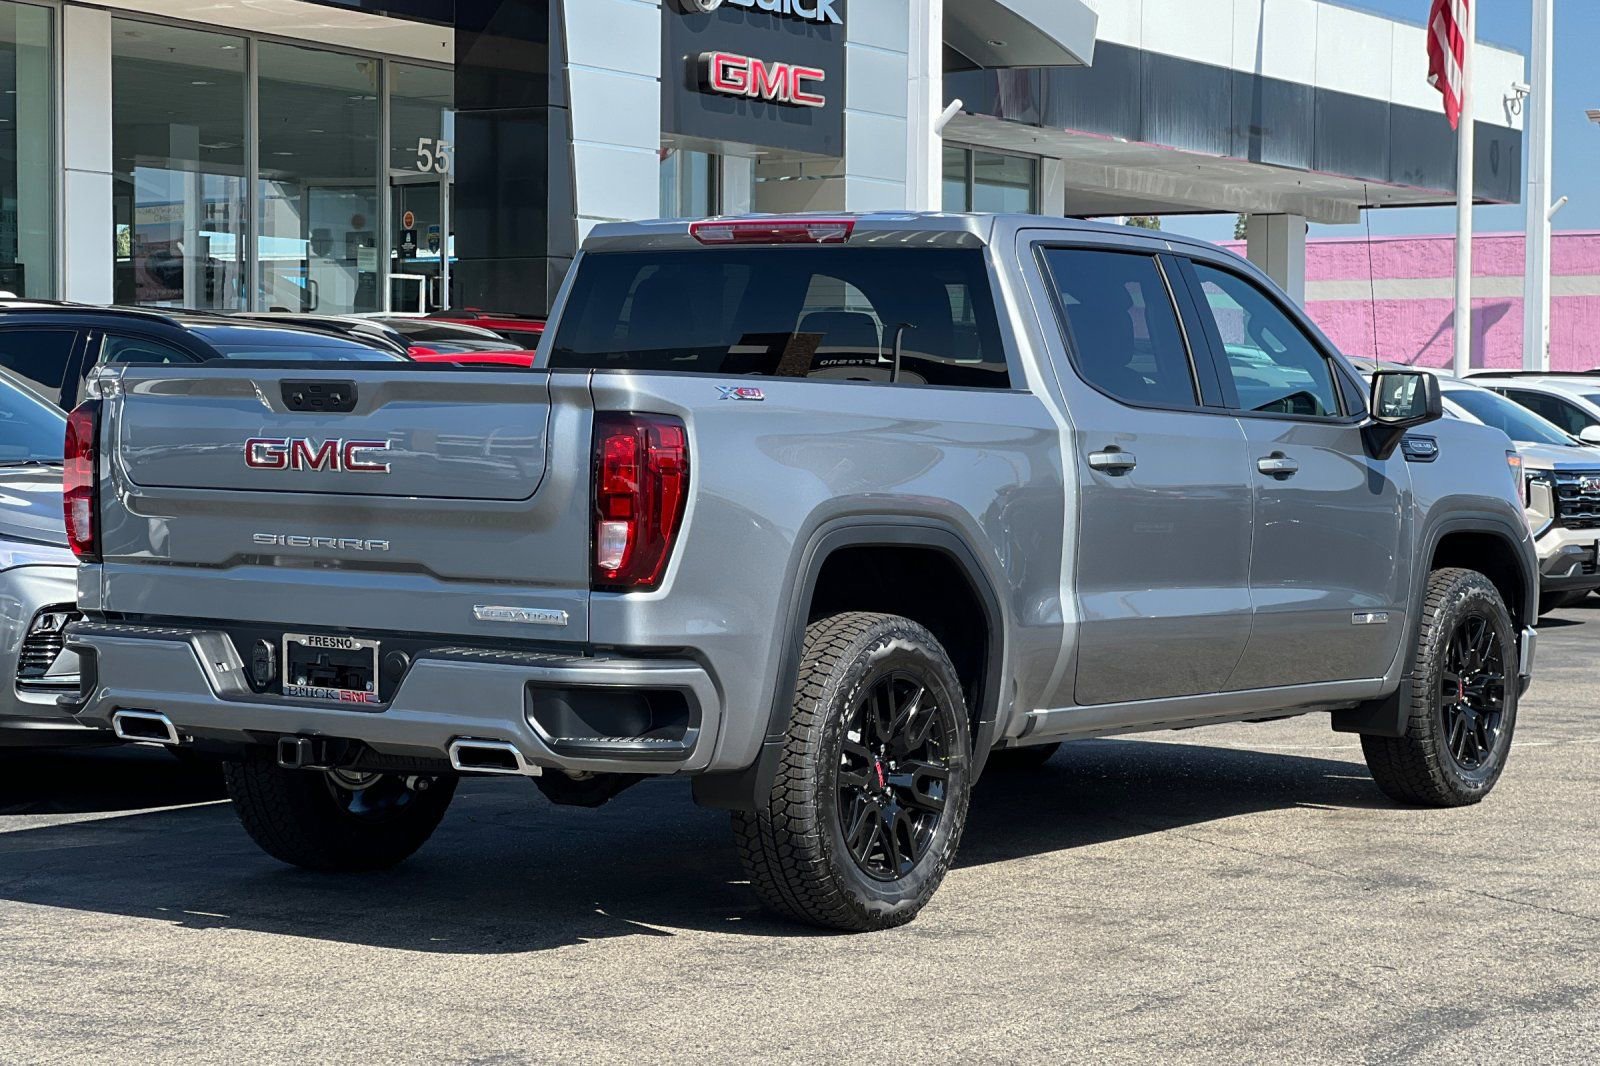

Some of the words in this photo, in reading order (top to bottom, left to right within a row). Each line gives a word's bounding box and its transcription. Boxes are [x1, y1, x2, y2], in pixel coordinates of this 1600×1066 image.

[711, 51, 825, 107] GMC
[417, 138, 449, 173] 55
[245, 437, 391, 474] GMC
[253, 533, 390, 550] SIERRA
[482, 609, 560, 621] ELEVATION
[308, 636, 352, 648] FRESNO
[340, 690, 375, 704] GMC
